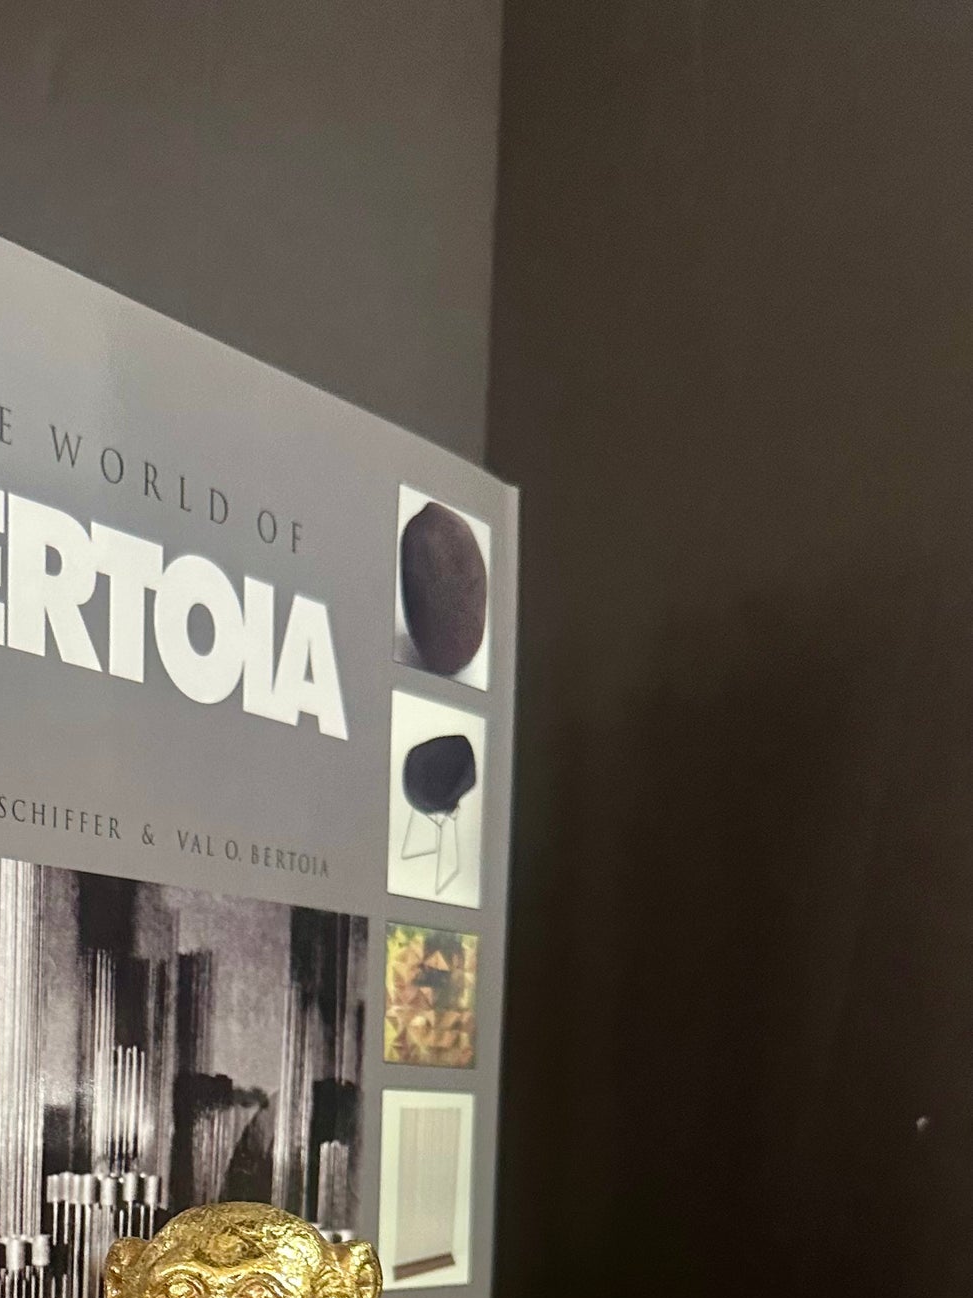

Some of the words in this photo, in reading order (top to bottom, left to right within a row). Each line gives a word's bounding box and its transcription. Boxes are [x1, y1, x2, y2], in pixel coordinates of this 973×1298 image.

[48, 424, 230, 526] WORLD
[256, 509, 304, 554] OF
[141, 823, 155, 847] &
[177, 829, 215, 857] VAL
[225, 839, 242, 862] O.
[250, 843, 329, 879] BERTOIA
